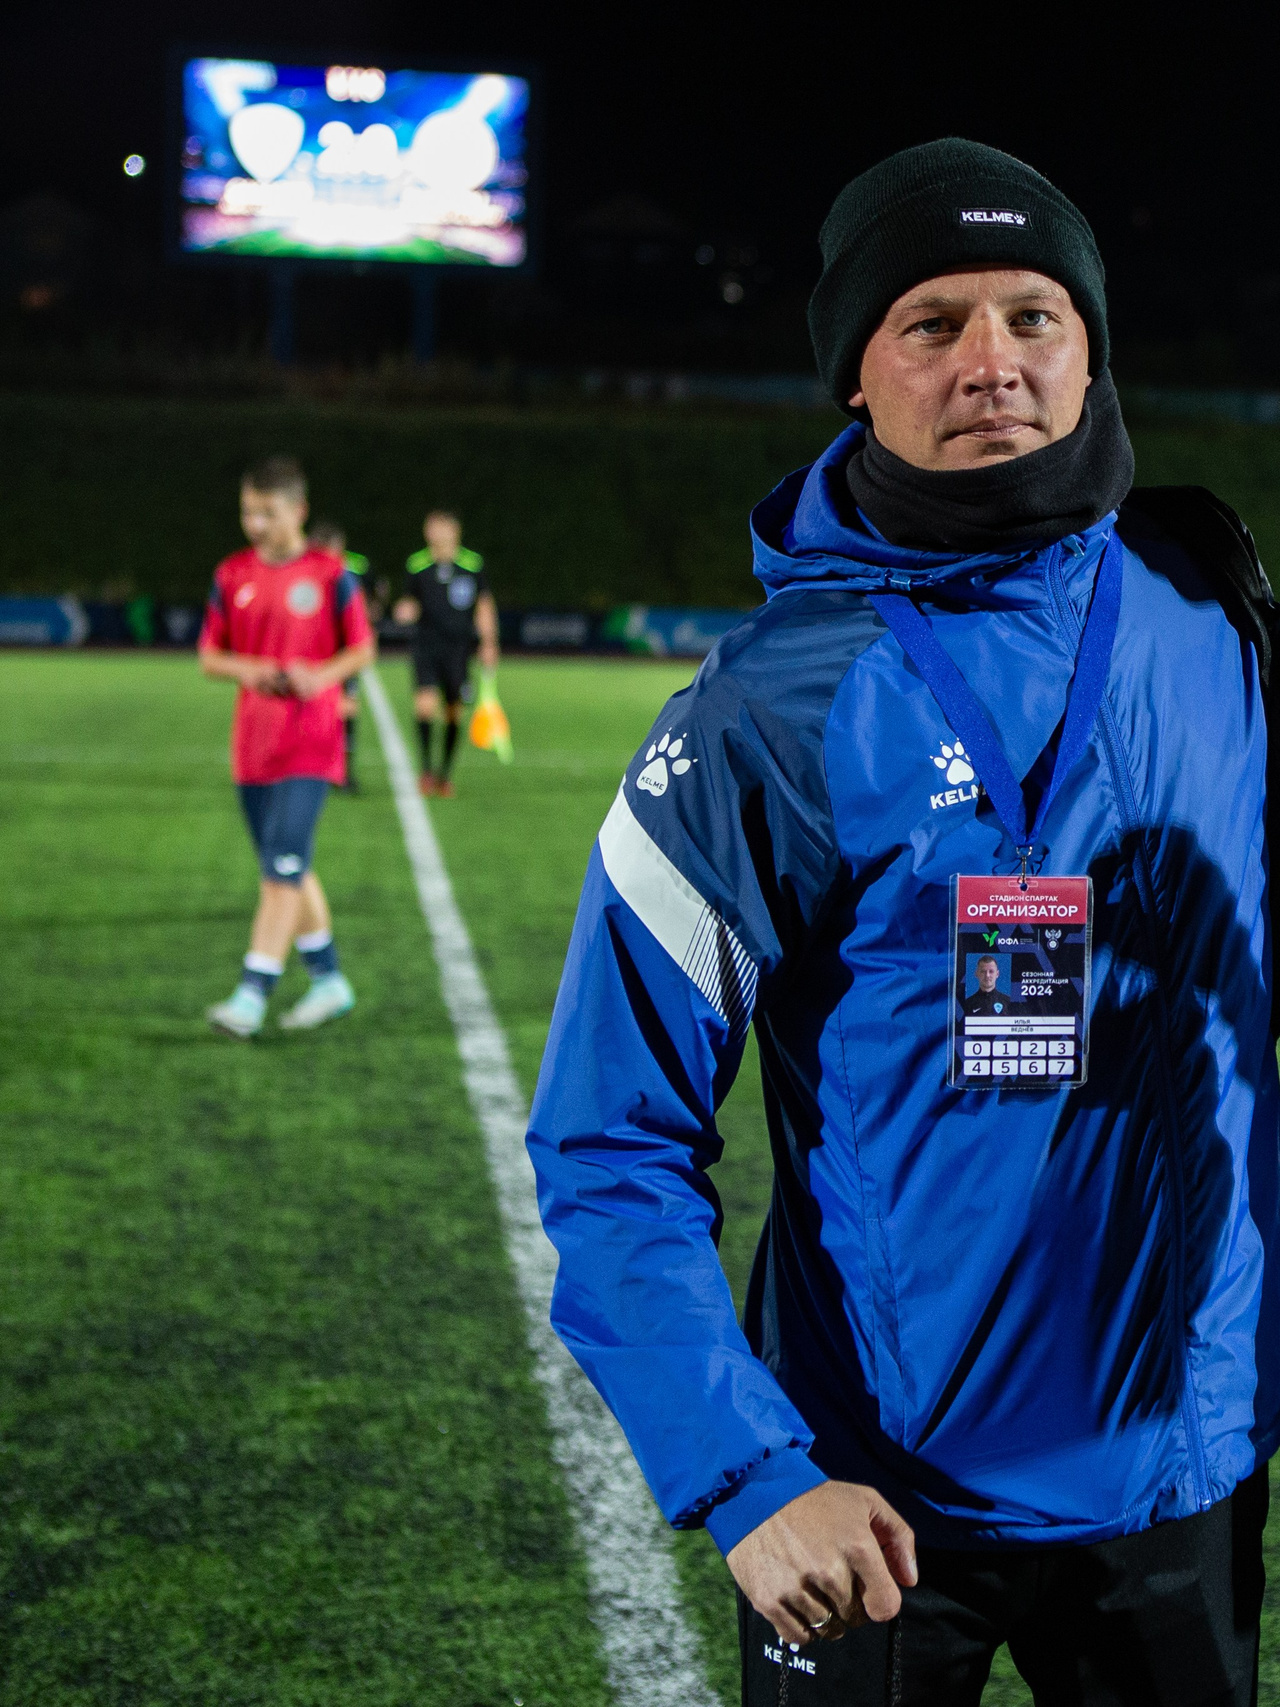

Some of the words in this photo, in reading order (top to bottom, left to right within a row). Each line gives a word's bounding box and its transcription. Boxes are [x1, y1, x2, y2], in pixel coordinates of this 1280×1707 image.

[961, 211, 1015, 223] KELME
[640, 776, 665, 791] KELME
[930, 784, 987, 810] KELM
[989, 894, 1024, 902] СТАДИОН
[1024, 894, 1058, 902] СПАРТАК
[966, 905, 1078, 917] ОРГАНИЗАТОР
[1021, 985, 1053, 996] 2024
[972, 1043, 982, 1055] 0
[1002, 1043, 1010, 1055] 1
[1029, 1043, 1038, 1055] 2
[1057, 1043, 1066, 1055] 3
[972, 1062, 982, 1074] 4
[1001, 1062, 1010, 1074] 5
[1029, 1062, 1038, 1074] 6
[1057, 1062, 1066, 1074] 7
